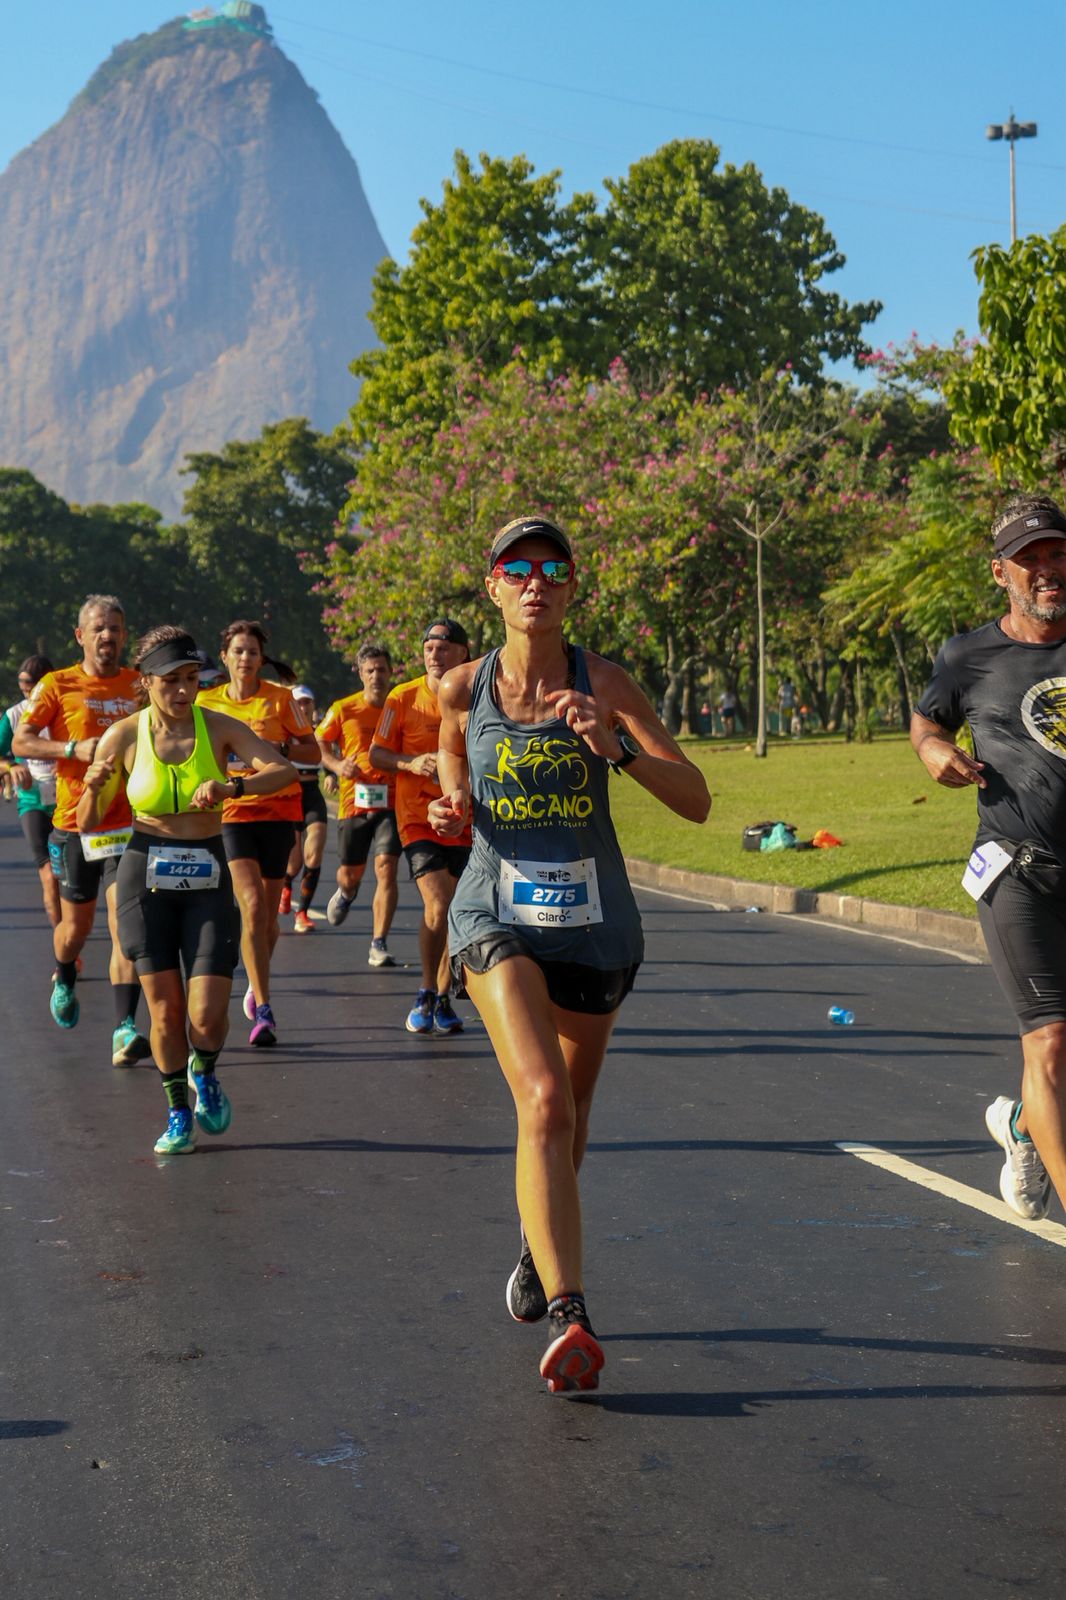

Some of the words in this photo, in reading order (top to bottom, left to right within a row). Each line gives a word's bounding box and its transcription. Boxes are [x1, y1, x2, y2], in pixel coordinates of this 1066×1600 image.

[489, 793, 593, 822] TOSCANO
[169, 865, 199, 876] 1447
[532, 888, 576, 903] 2775
[537, 911, 567, 923] Claro
